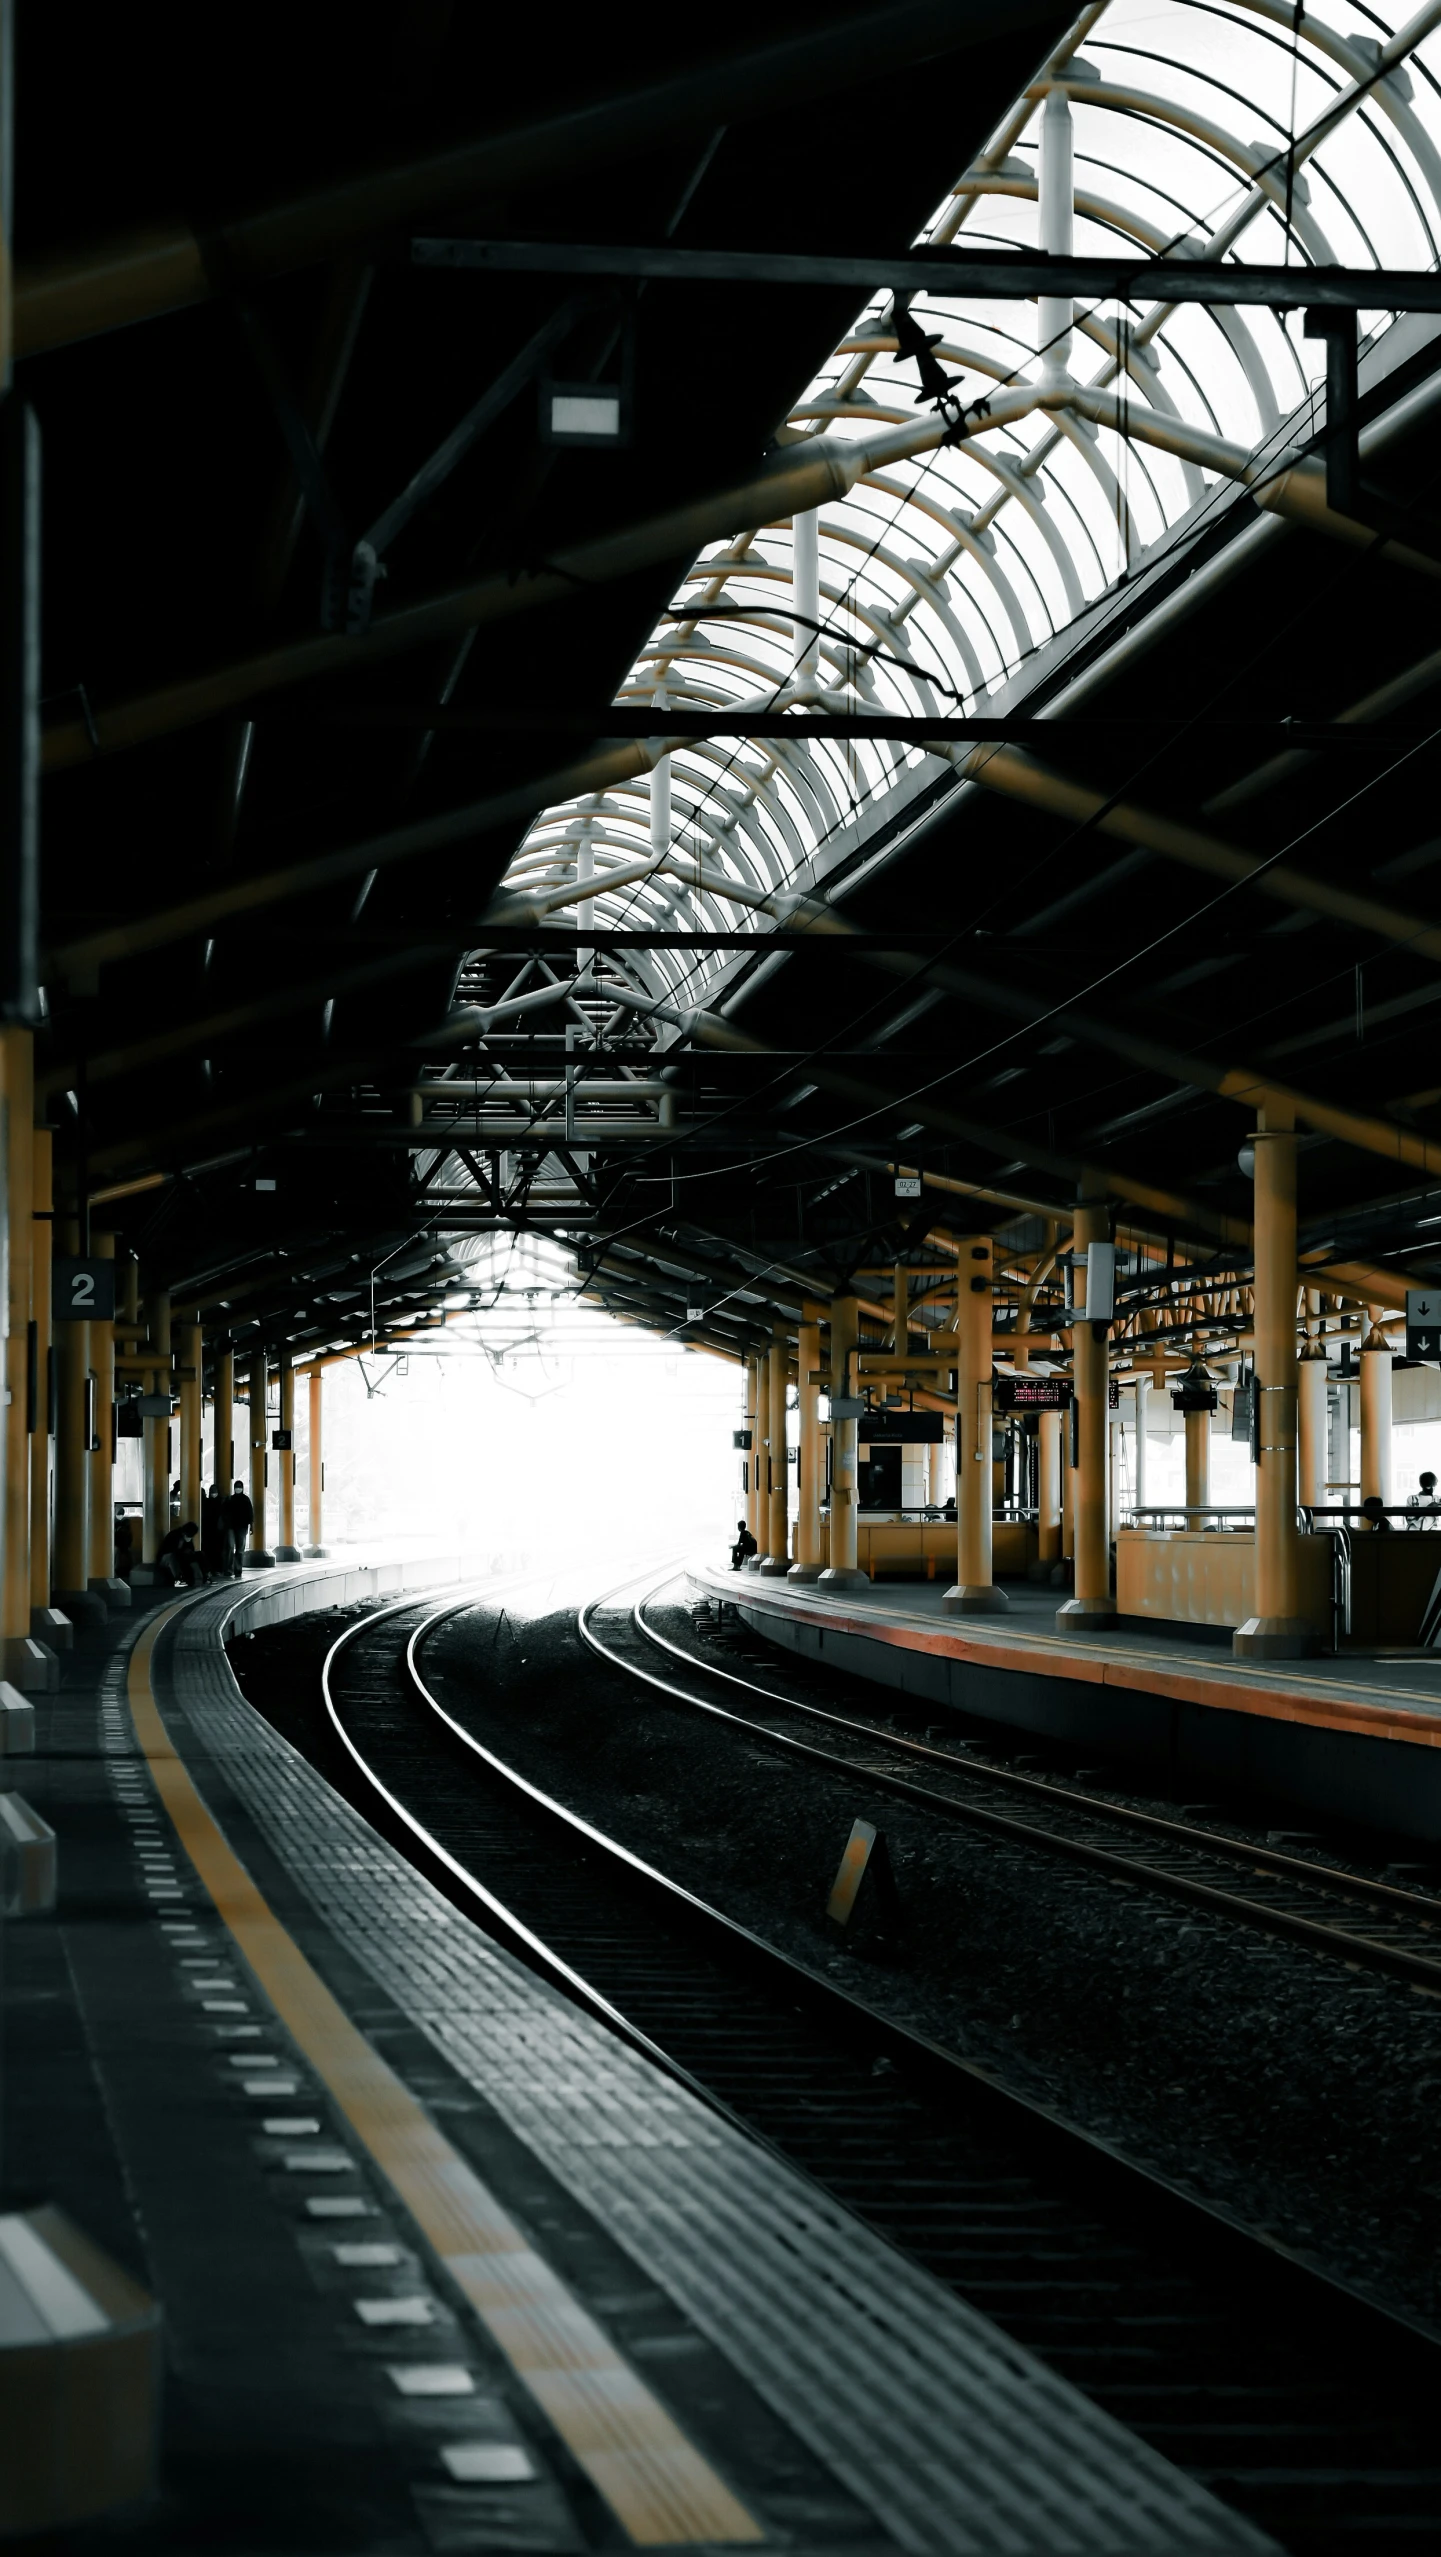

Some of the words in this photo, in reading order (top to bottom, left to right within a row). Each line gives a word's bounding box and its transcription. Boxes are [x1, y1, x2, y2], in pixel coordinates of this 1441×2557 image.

[71, 1273, 95, 1306] 2
[882, 1415, 887, 1424] 1
[277, 1435, 286, 1446] 2
[739, 1435, 745, 1446] 1
